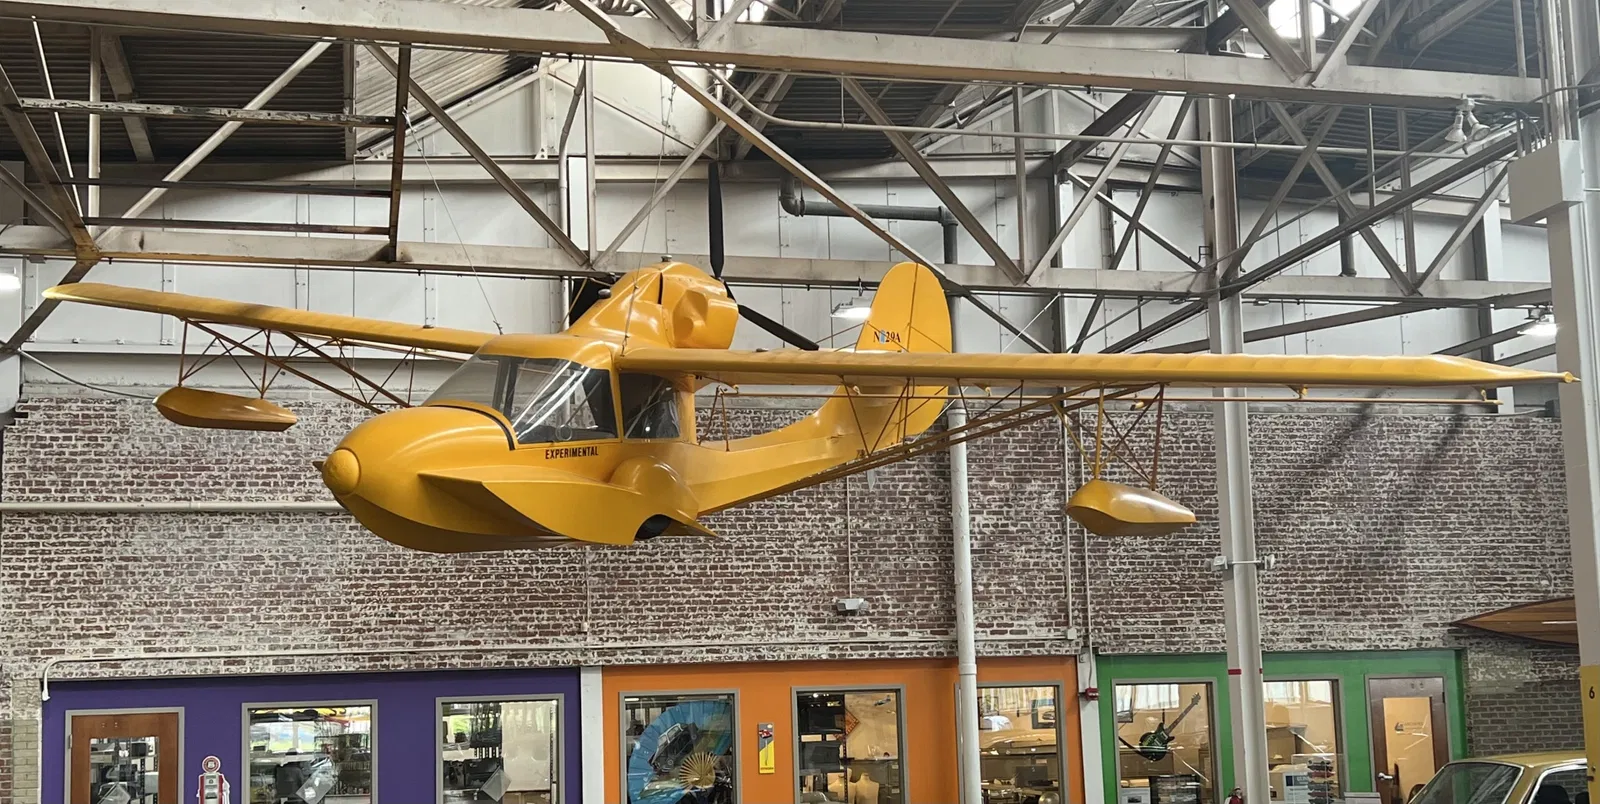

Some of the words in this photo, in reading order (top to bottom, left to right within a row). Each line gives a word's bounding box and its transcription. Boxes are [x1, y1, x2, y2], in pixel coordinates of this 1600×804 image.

[873, 330, 901, 343] N29A
[545, 446, 599, 459] EXPERIMENTAL
[1589, 686, 1595, 699] 6
